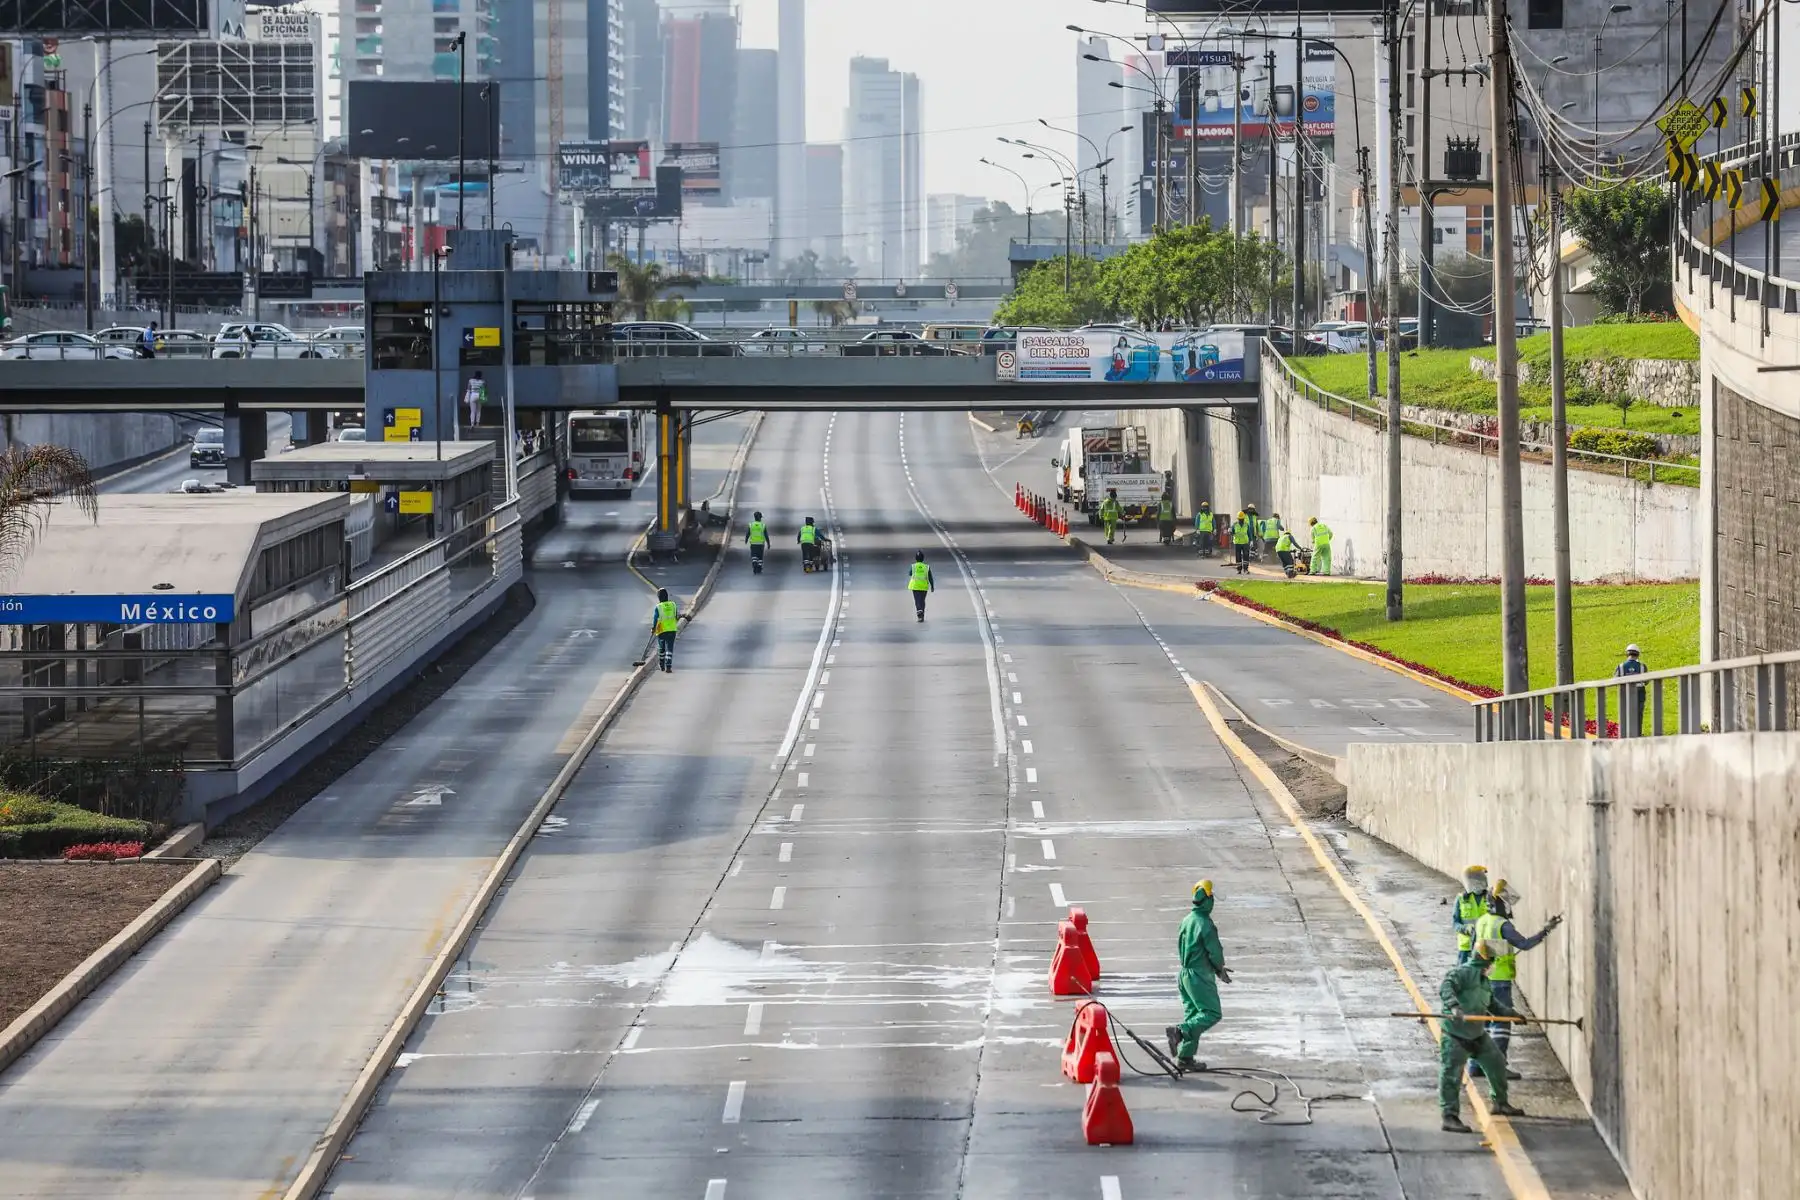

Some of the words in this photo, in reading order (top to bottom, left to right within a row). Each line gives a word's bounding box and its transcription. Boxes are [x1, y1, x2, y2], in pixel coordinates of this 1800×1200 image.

[262, 15, 273, 25] SE
[275, 15, 309, 25] ALQUILA
[262, 25, 309, 34] OFICINAS
[1184, 127, 1234, 137] HRAOKA
[562, 154, 607, 165] WINIA
[1022, 336, 1084, 348] ¡SALGAMOS
[1030, 347, 1057, 359] BIEN,
[1219, 371, 1242, 380] LIMA
[121, 602, 217, 620] México
[1259, 698, 1431, 709] PASO
